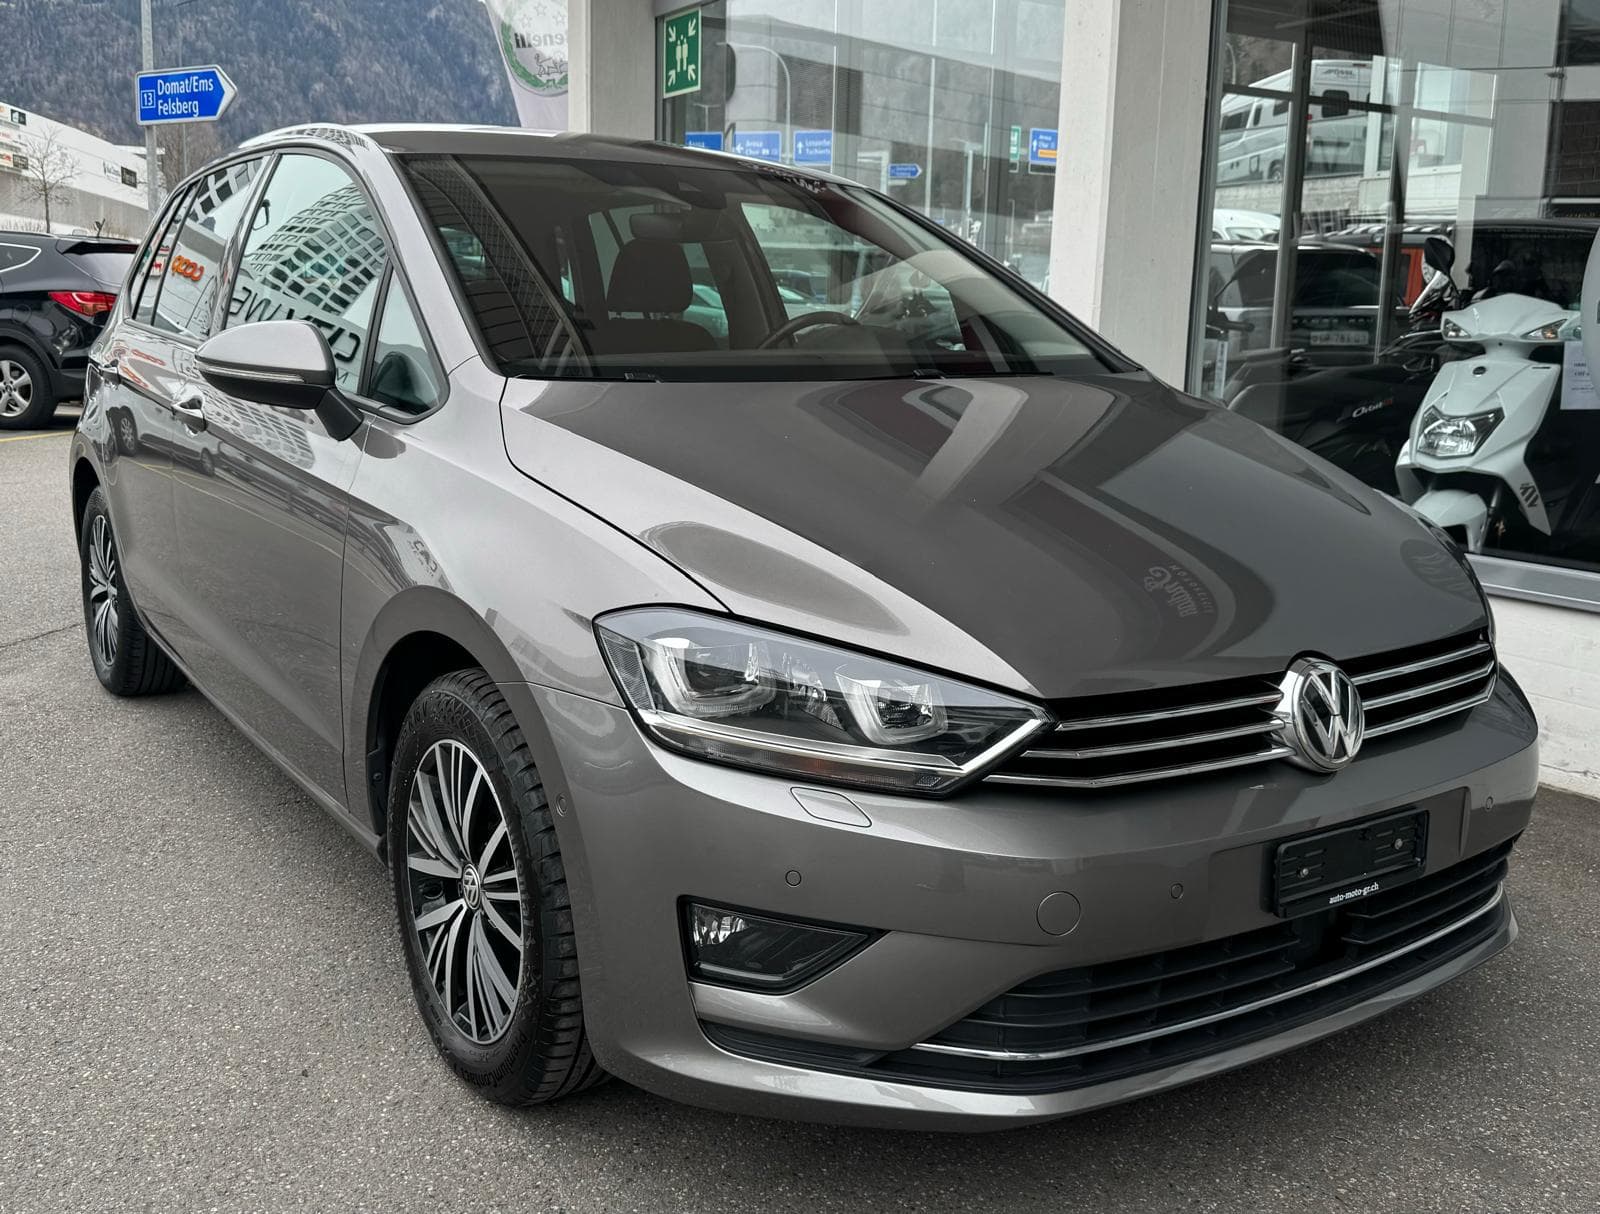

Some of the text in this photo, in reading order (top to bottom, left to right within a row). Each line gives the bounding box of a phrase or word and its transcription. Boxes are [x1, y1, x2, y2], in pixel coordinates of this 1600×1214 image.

[157, 76, 214, 95] Domat/Ems
[143, 92, 153, 106] 13
[157, 98, 199, 117] Felsberg
